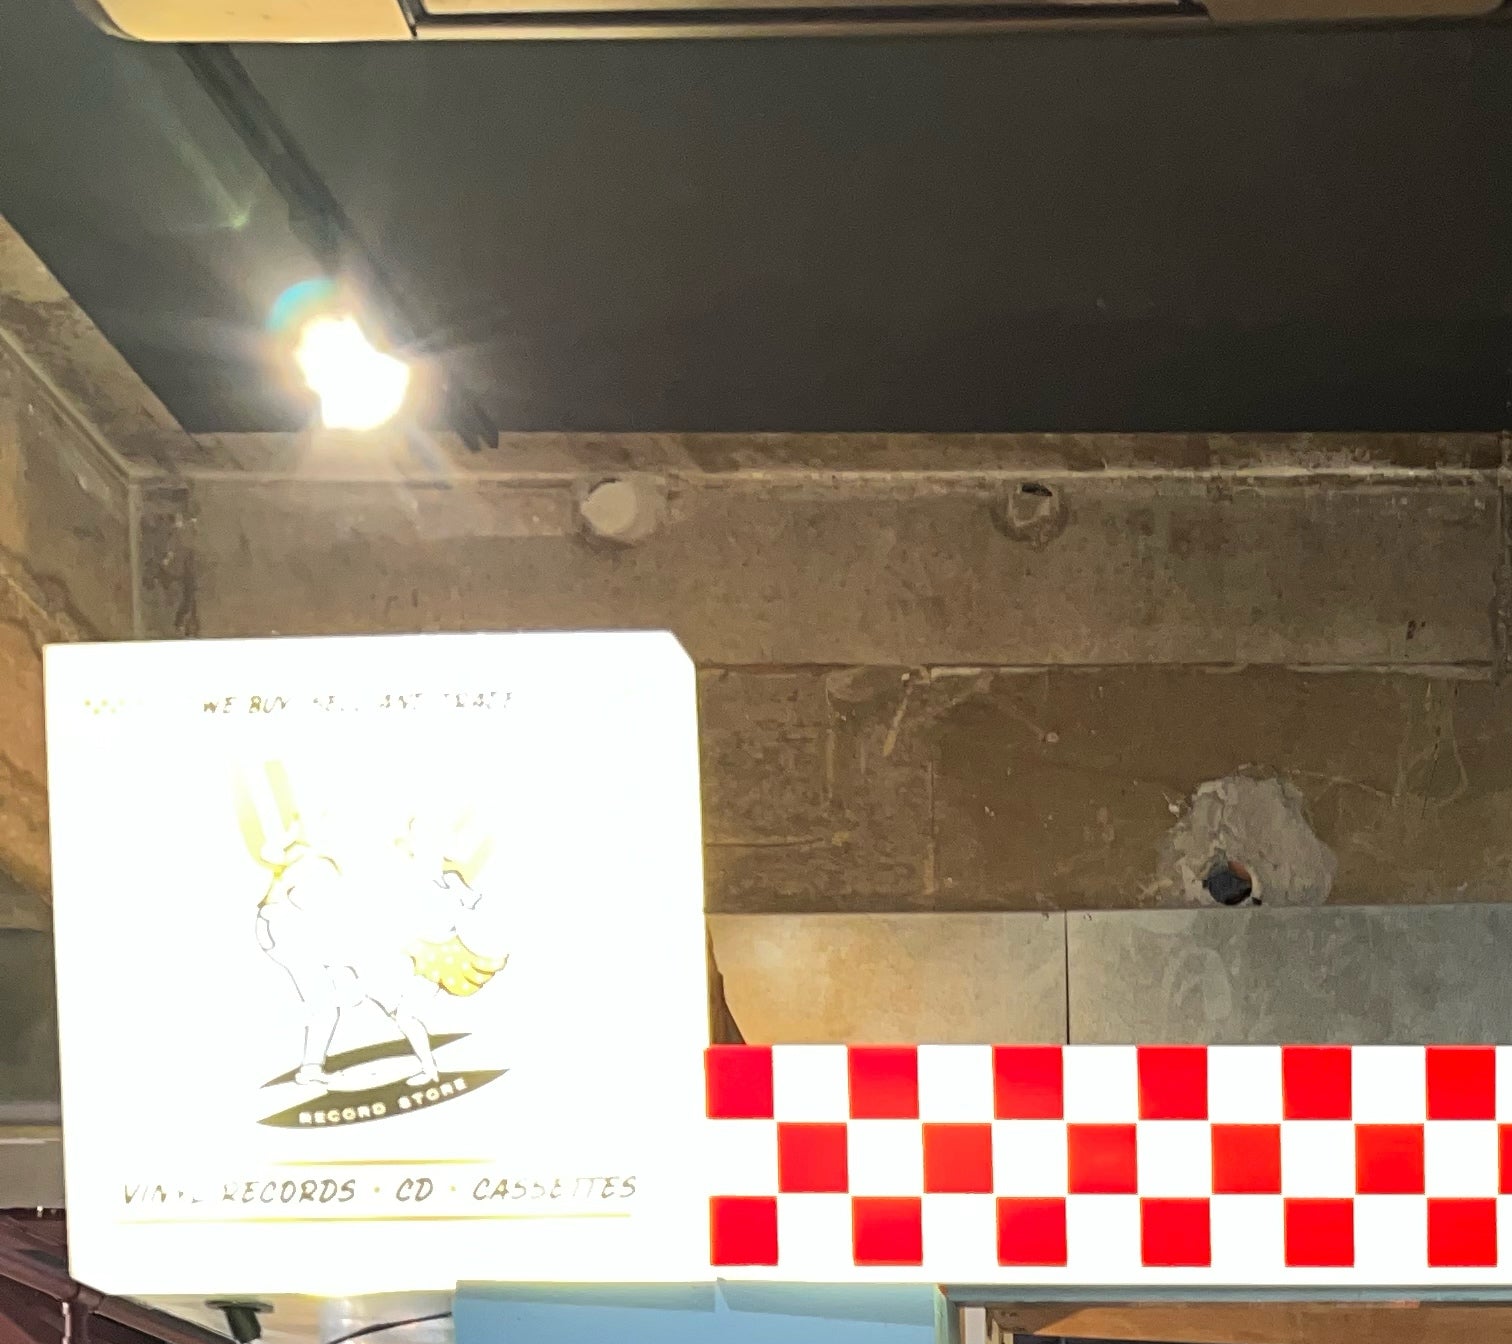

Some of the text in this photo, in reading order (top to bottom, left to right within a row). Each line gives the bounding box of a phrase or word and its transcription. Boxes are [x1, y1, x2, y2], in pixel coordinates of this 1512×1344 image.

[299, 1077, 467, 1125] RECORD STORE
[223, 1179, 356, 1204] RECORDS
[396, 1178, 434, 1202] CD
[473, 1176, 636, 1201] CASSETTES
